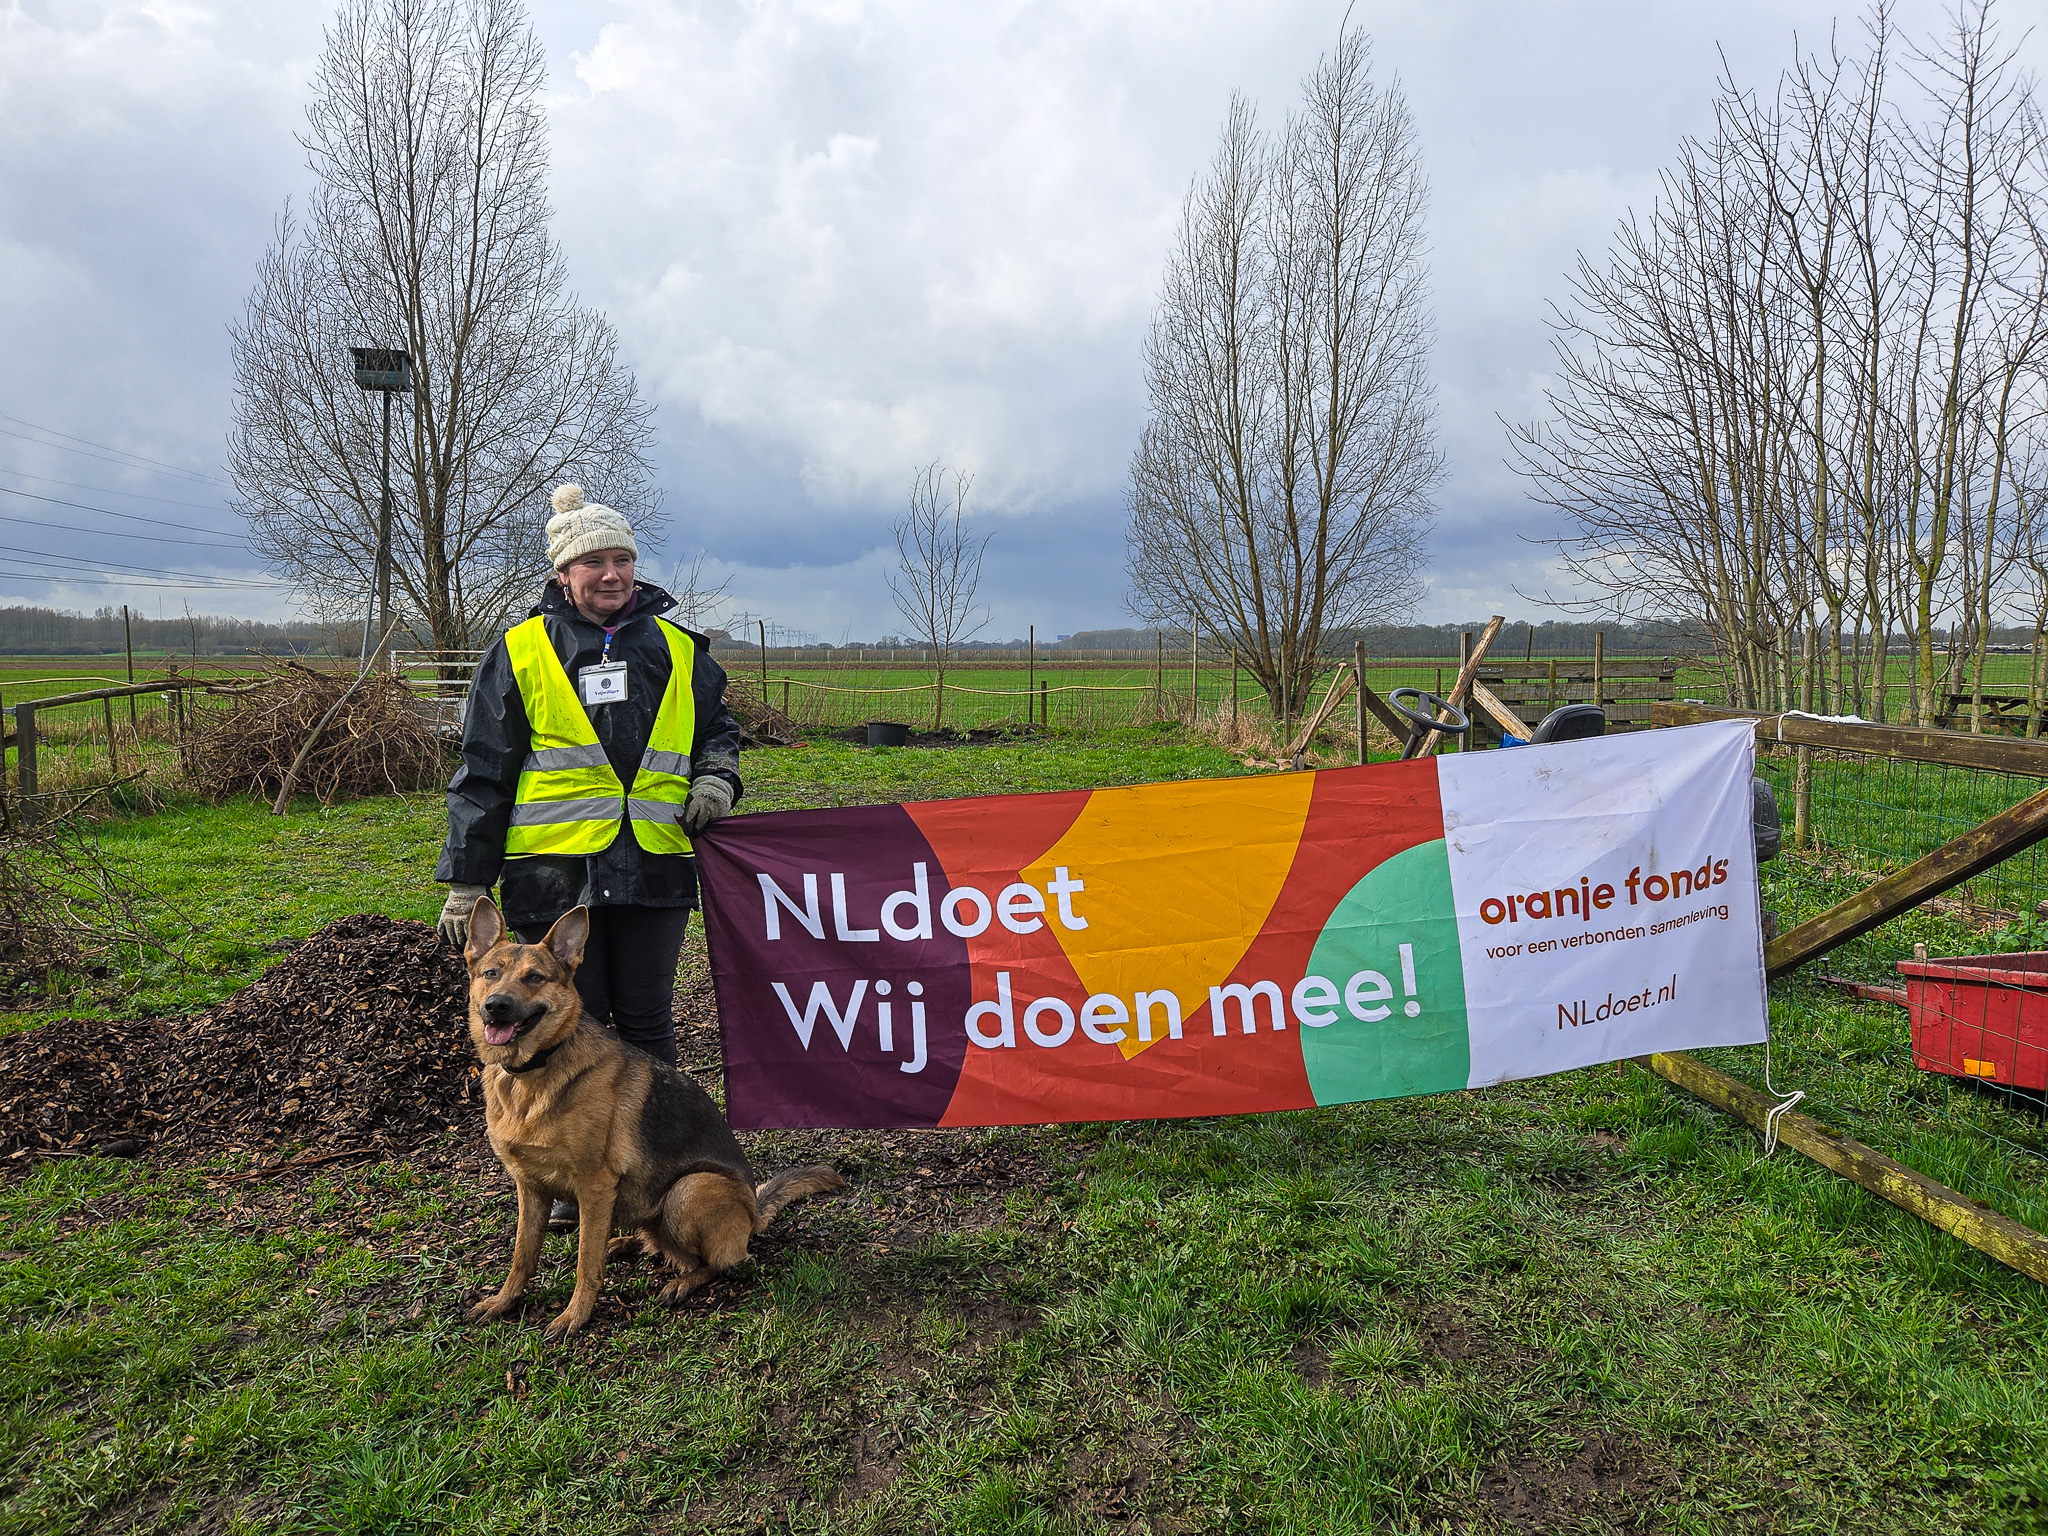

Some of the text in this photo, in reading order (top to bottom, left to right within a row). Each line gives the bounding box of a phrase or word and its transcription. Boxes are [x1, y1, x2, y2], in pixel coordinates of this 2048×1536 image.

[756, 862, 1090, 942] NLdoet
[1480, 855, 1730, 925] oranje fonds
[1486, 904, 1730, 960] voor een verbonden samenleving
[771, 943, 1422, 1074] Wij doen mee!
[1557, 974, 1677, 1031] NLdoet.nl
